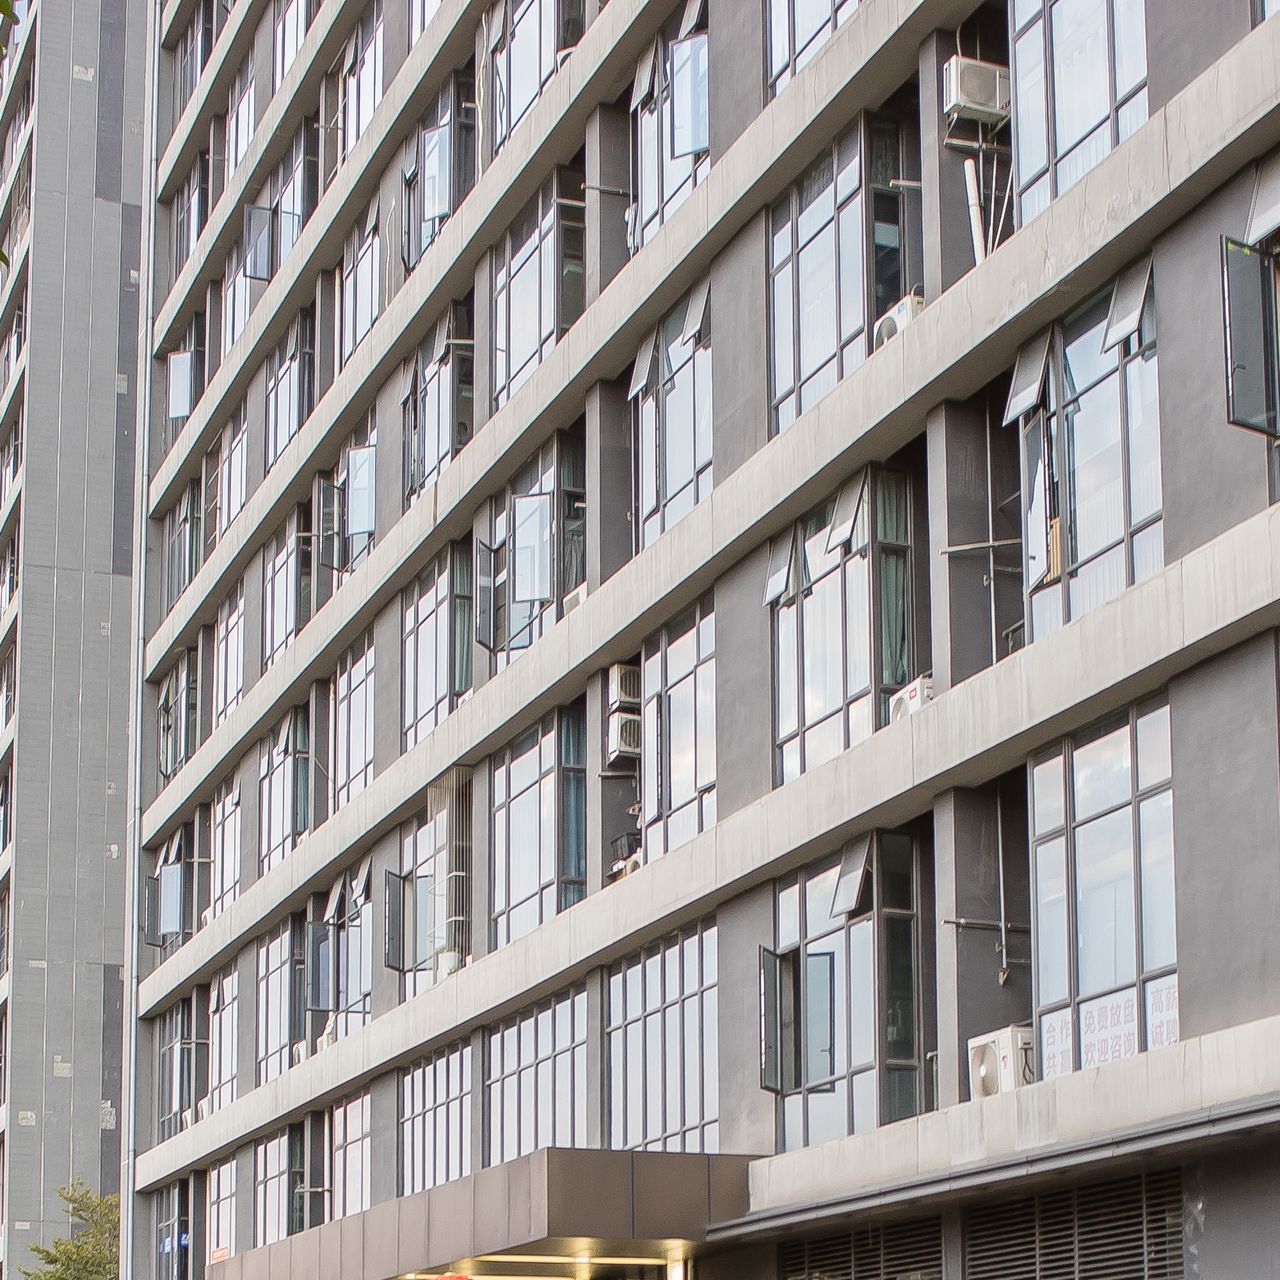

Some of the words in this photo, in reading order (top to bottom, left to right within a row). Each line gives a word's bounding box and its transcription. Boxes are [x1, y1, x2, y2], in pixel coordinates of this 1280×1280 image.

[1046, 1018, 1071, 1047] 合作
[1084, 998, 1135, 1034] 免费放盘
[1084, 1031, 1136, 1067] 欢迎咨询
